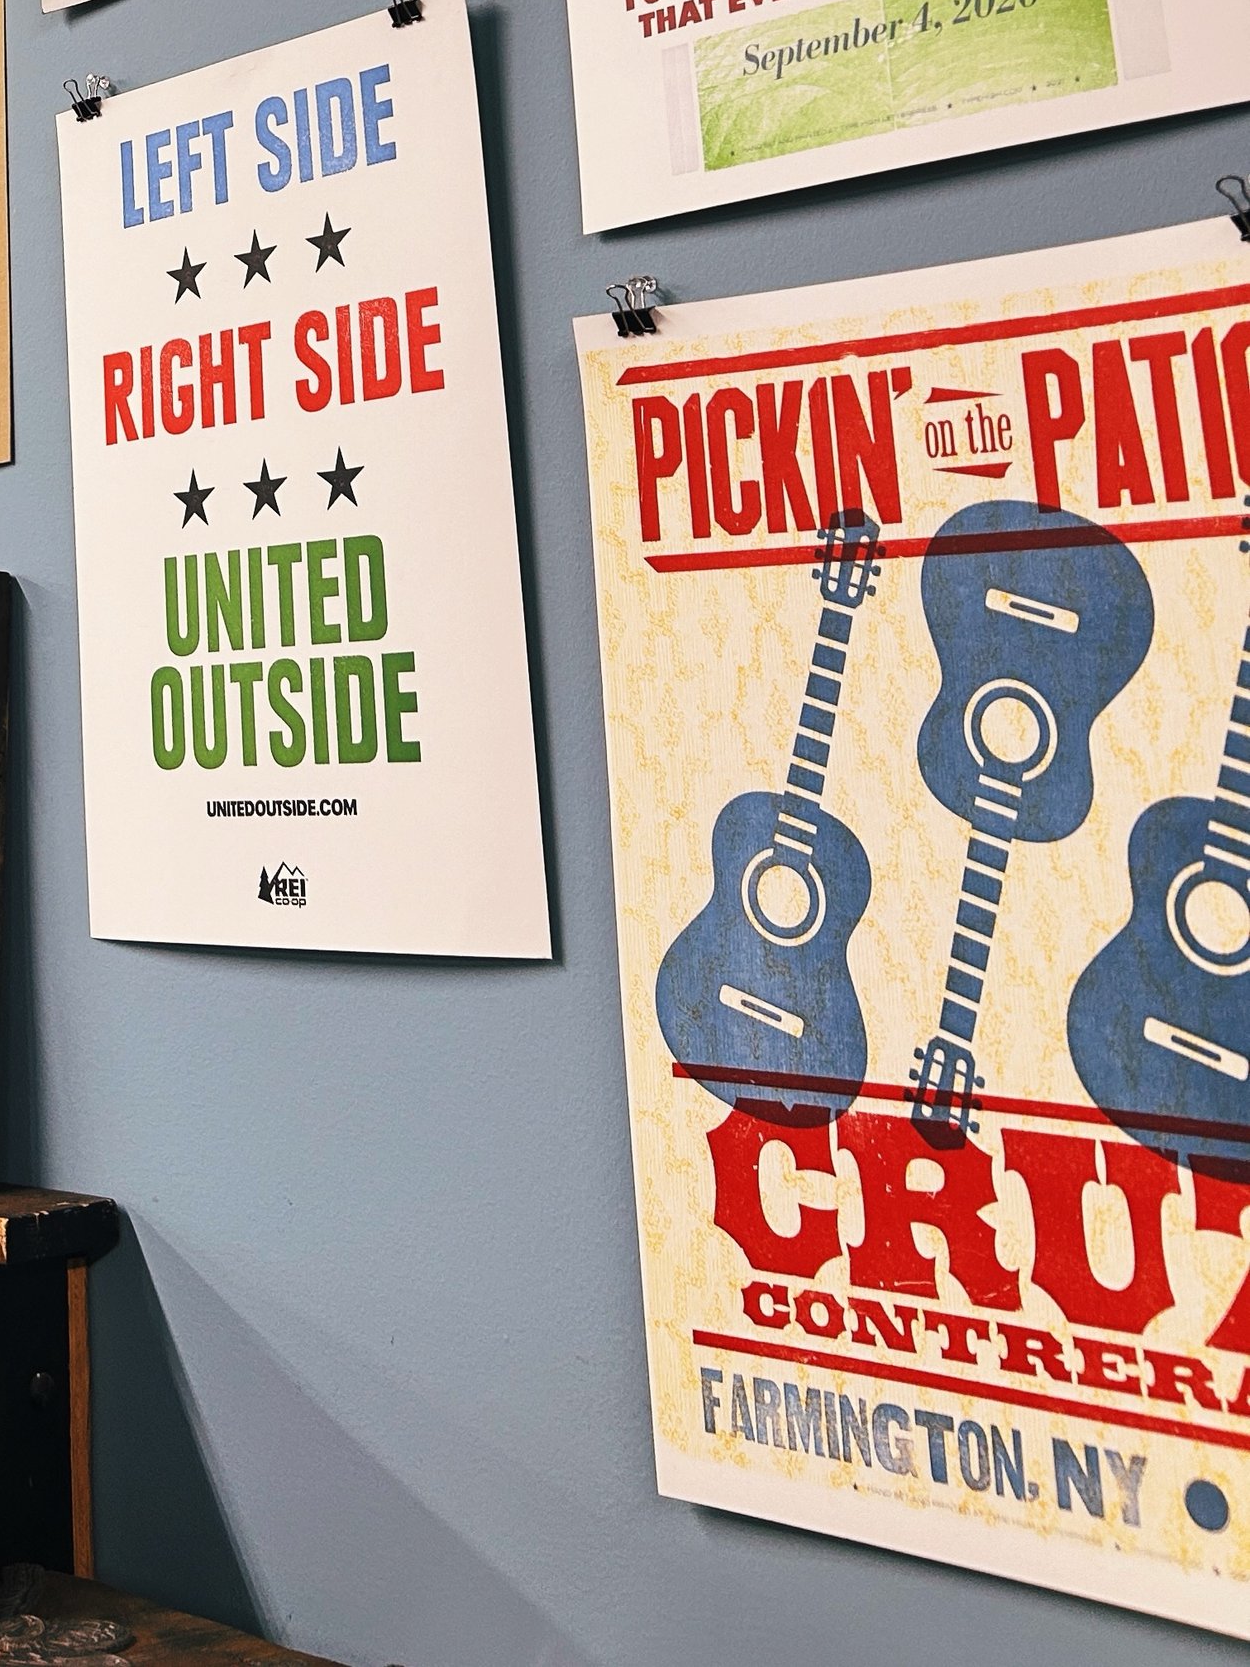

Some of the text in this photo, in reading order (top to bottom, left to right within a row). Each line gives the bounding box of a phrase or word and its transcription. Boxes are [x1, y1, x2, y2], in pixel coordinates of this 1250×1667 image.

[741, 16, 903, 80] September
[910, 2, 944, 38] 4,
[120, 63, 397, 228] LEFT SIDE
[103, 286, 445, 446] RIGHT SIDE
[632, 366, 913, 542] PICKIN'
[925, 416, 958, 459] on
[964, 404, 1013, 453] the
[163, 534, 388, 656] UNITED
[151, 651, 422, 770] OUTSIDE
[206, 798, 358, 817] UNITEDOUTSIDE.COM
[275, 878, 306, 897] REI
[700, 1367, 1040, 1503] FARMINGTON,
[1054, 1439, 1147, 1529] NY
